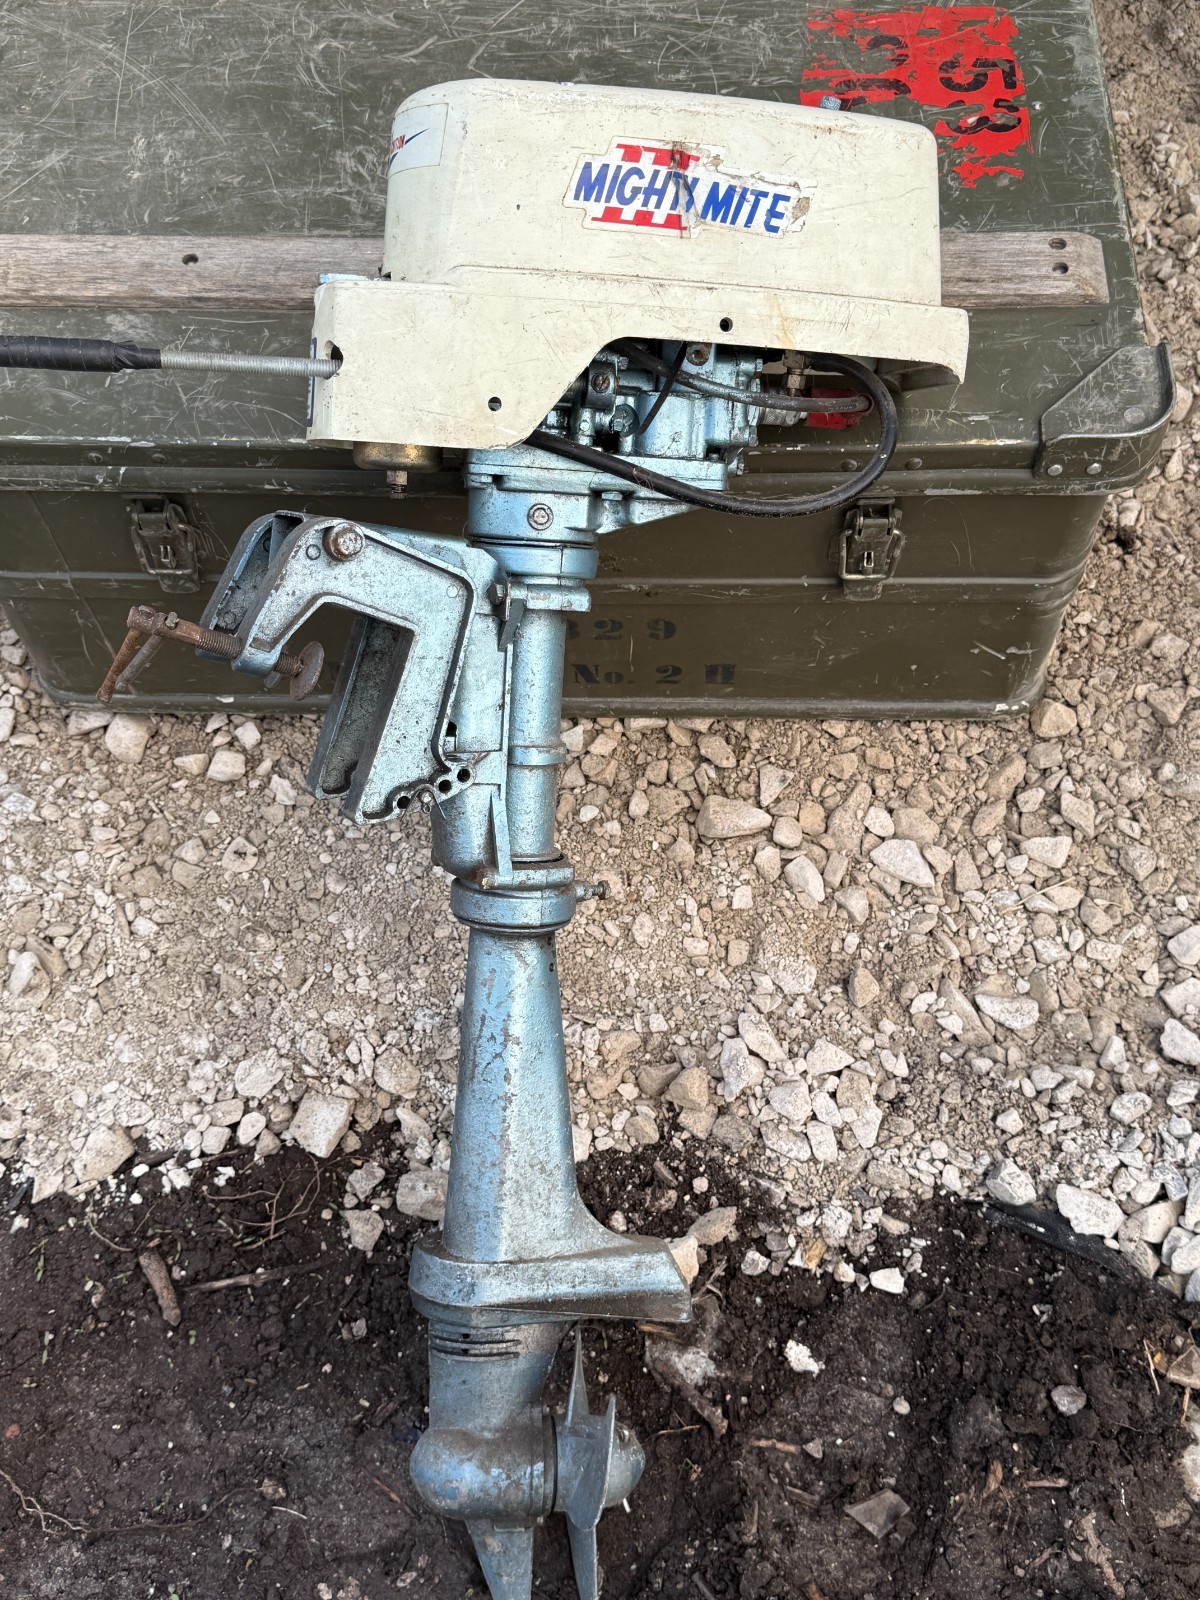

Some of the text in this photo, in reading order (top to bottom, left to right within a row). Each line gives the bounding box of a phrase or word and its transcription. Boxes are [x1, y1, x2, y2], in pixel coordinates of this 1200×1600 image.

[573, 162, 792, 234] MIGHTY MITE
[571, 663, 635, 685] No.
[655, 664, 684, 685] 2
